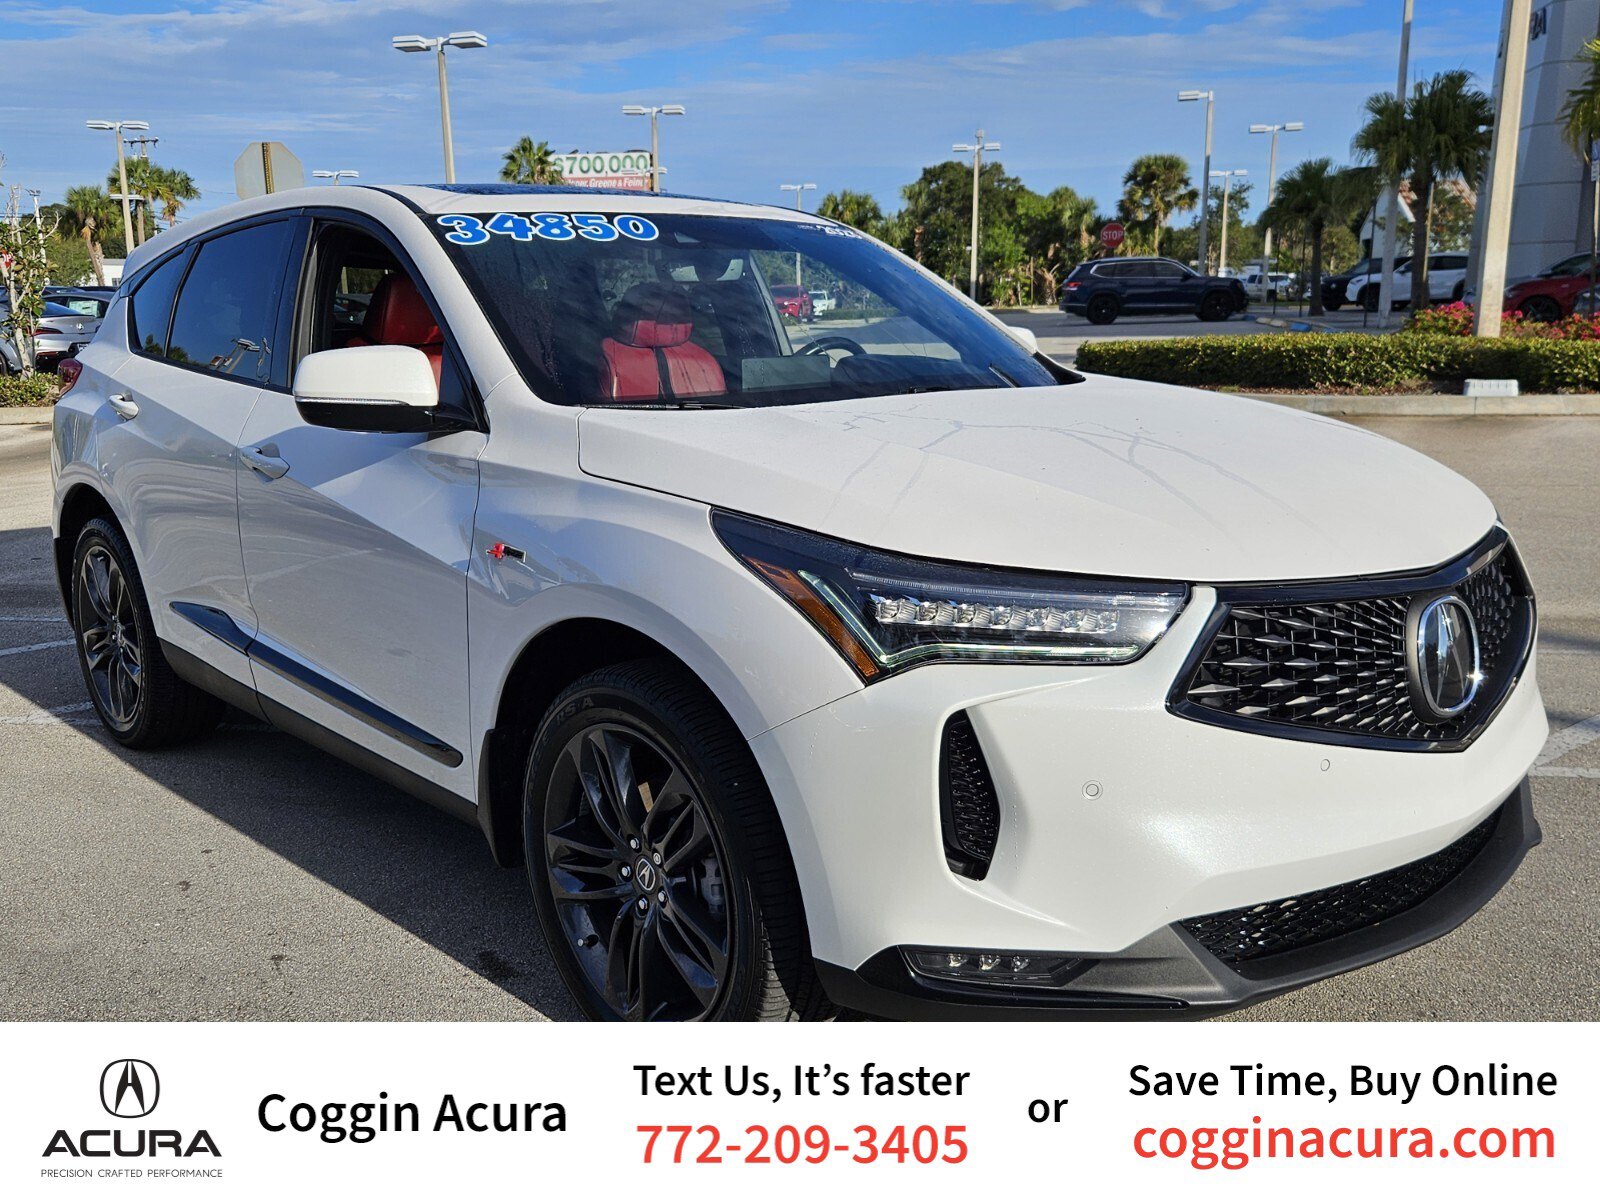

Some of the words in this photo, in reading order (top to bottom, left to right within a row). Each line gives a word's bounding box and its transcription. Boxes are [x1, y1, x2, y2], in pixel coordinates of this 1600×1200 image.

[554, 154, 648, 177] $700,000
[436, 212, 660, 246] 34850
[1102, 230, 1124, 241] STOP
